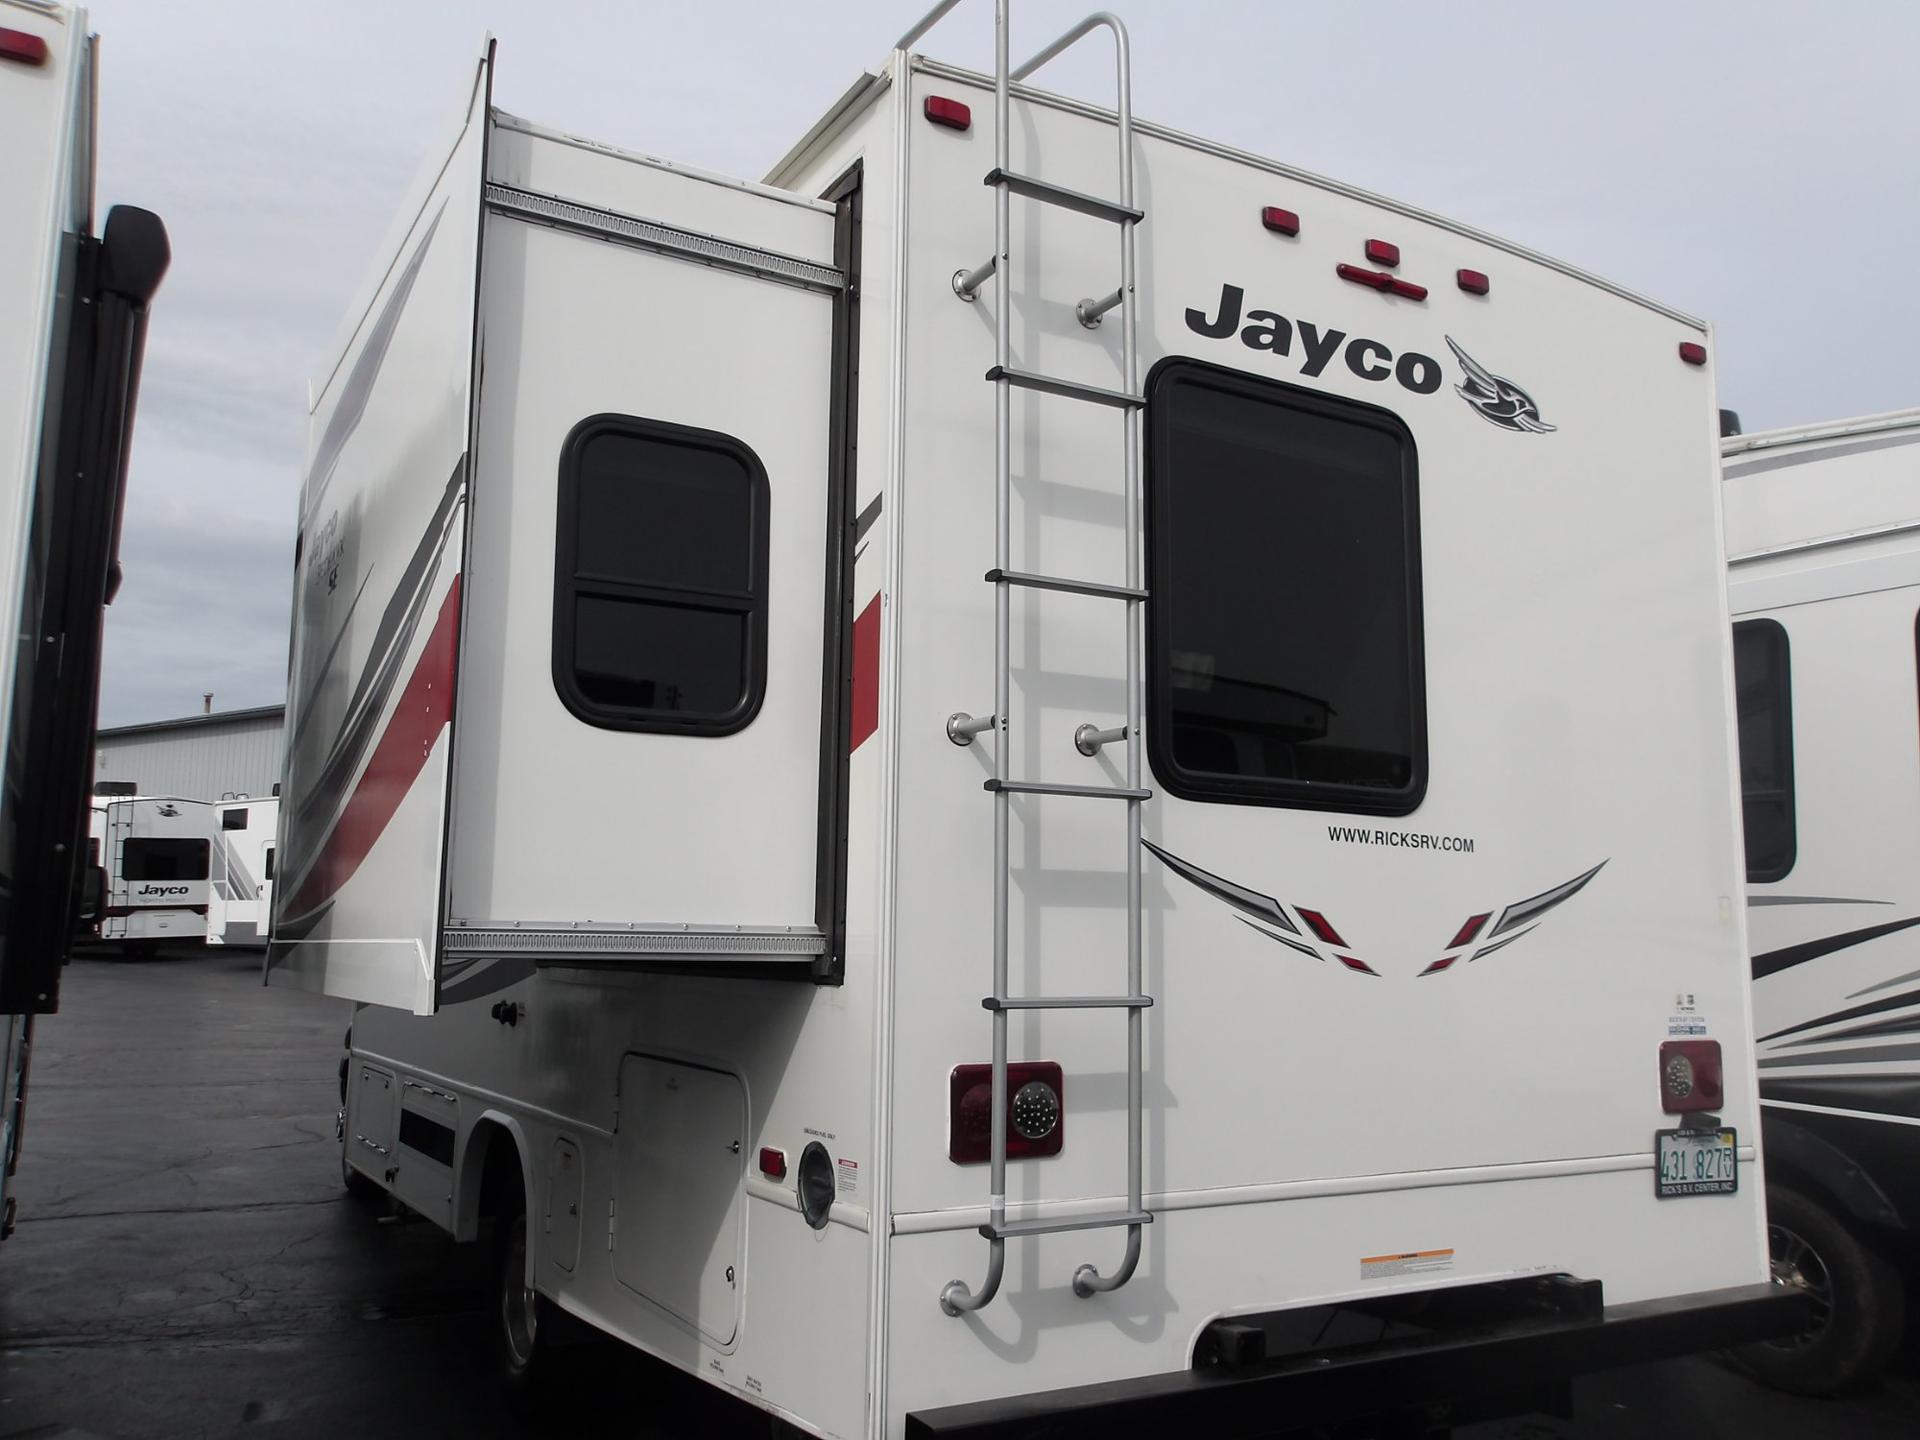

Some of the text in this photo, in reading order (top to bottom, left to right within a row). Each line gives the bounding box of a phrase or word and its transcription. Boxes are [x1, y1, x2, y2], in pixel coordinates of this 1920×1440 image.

[1185, 283, 1442, 395] Jayco
[1327, 826, 1474, 853] WWW.RICKSRV.COM
[138, 884, 189, 897] Jayco
[1661, 1148, 1722, 1181] 431 827
